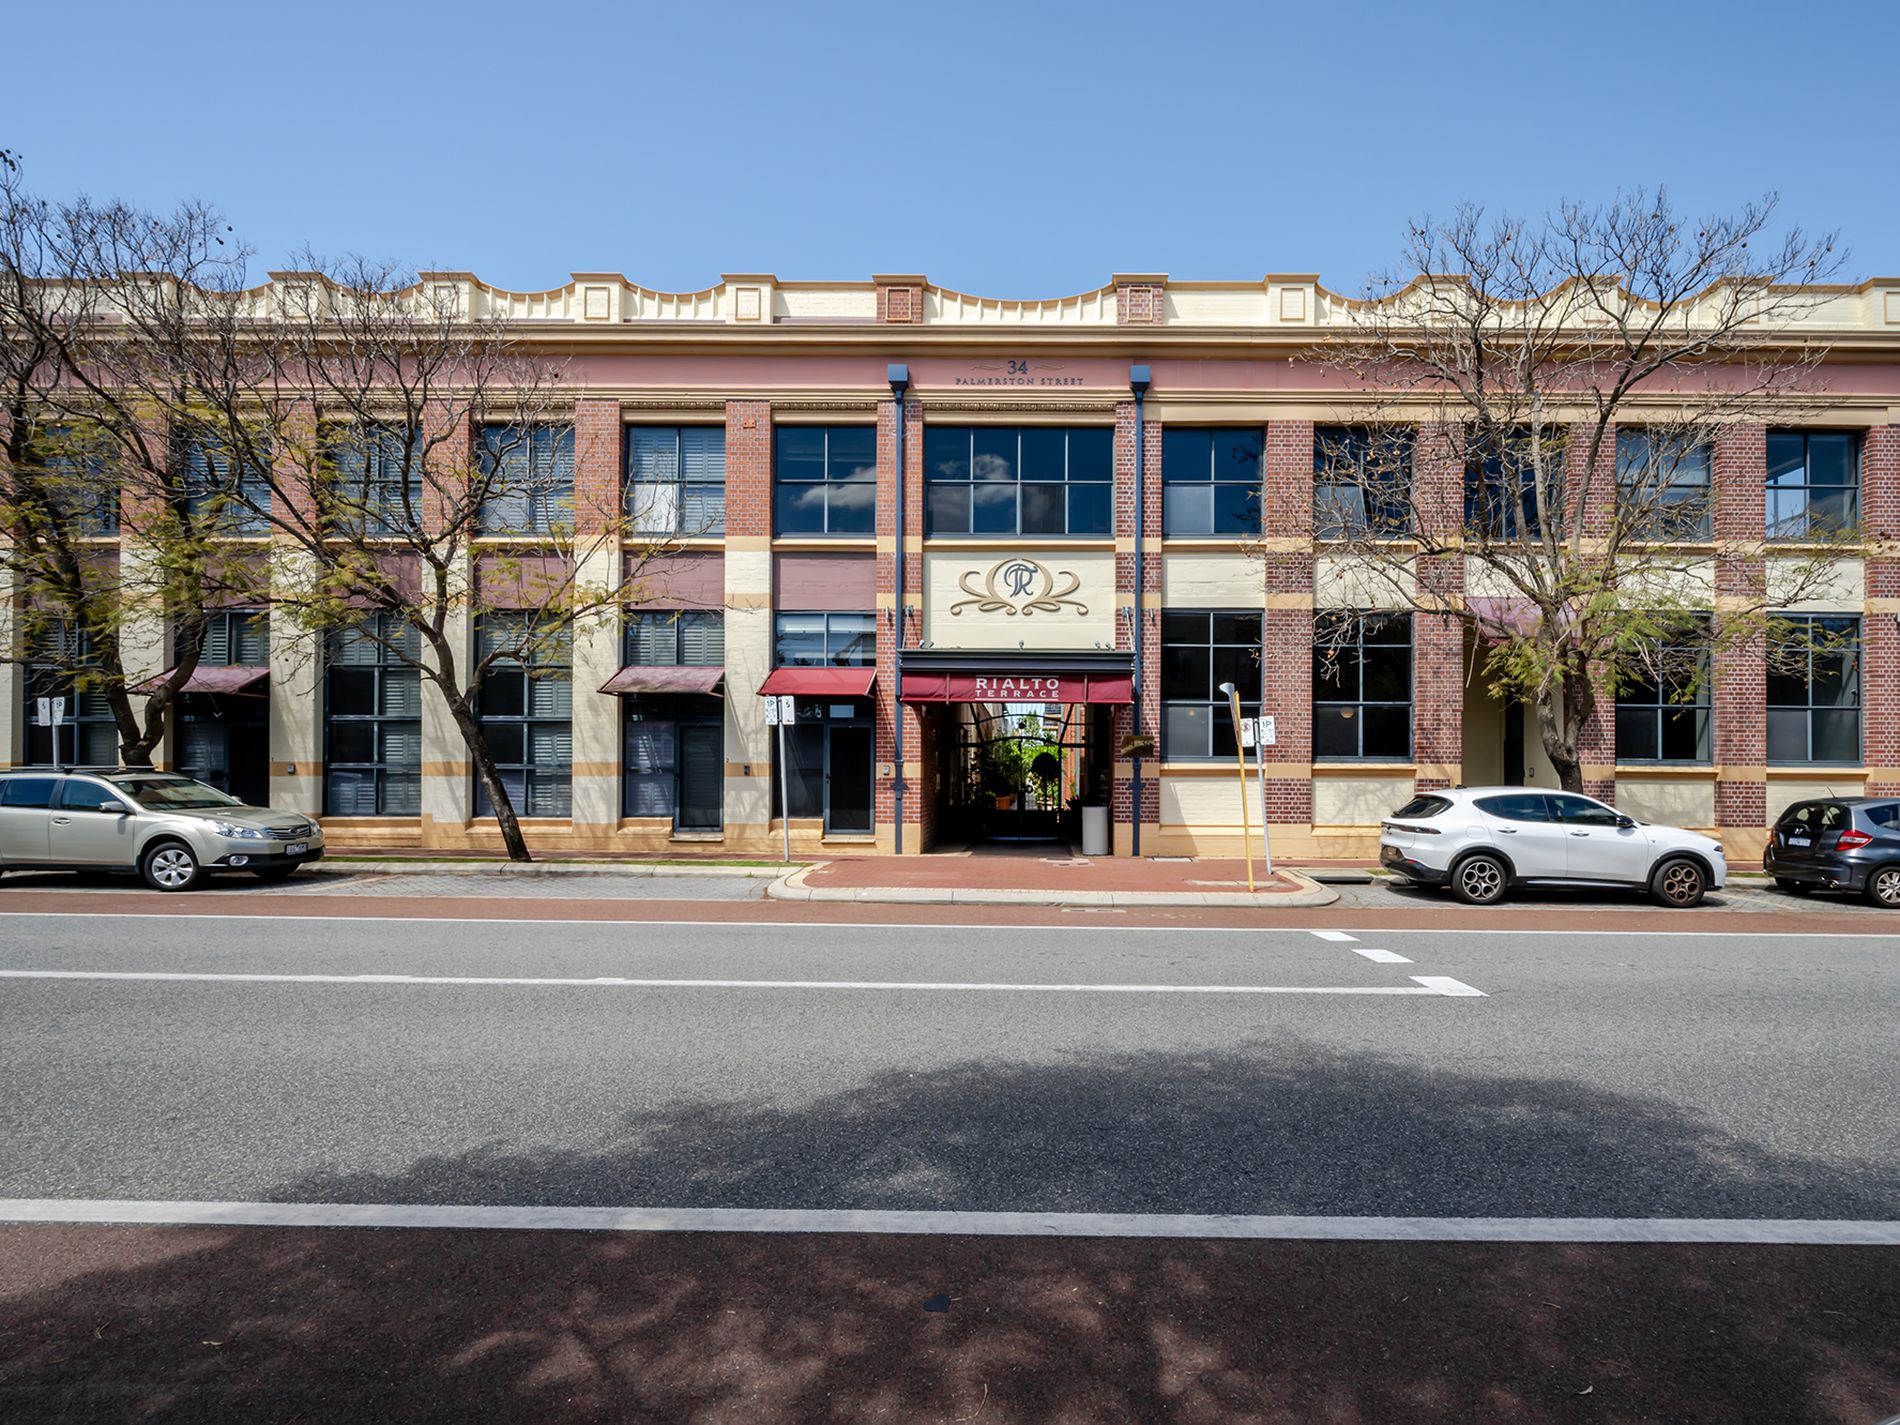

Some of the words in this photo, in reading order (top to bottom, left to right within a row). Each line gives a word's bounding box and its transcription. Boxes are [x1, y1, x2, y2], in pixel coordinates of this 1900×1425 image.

[1007, 360, 1028, 375] 34
[955, 377, 1035, 386] PALMERSTON
[1040, 377, 1084, 386] STREET
[975, 677, 1059, 690] RIALTO
[975, 689, 1059, 698] TERRACE
[1261, 719, 1272, 728] 1P
